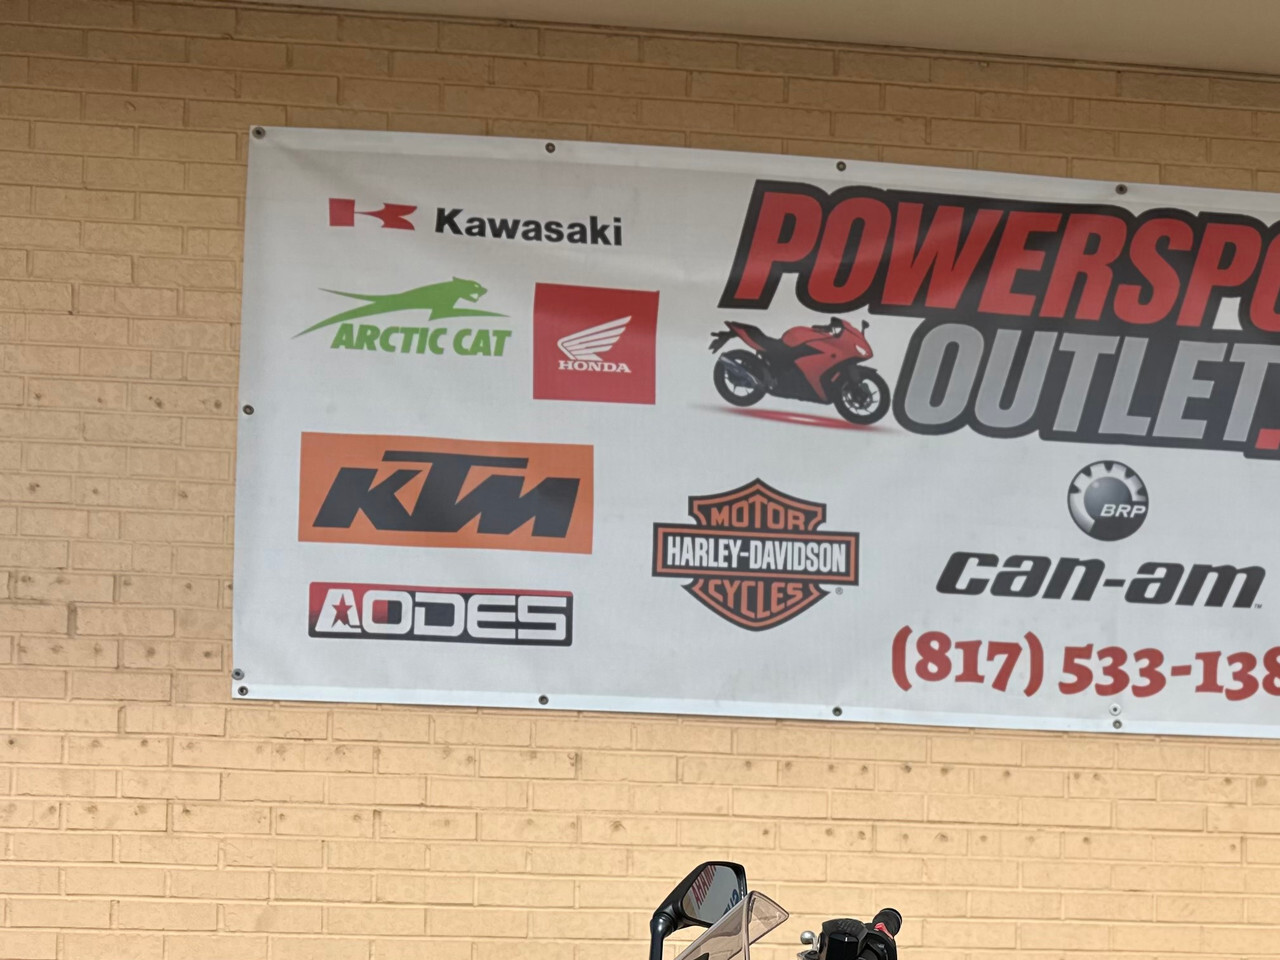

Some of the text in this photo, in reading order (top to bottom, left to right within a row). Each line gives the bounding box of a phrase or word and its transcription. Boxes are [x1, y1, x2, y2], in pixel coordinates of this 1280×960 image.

[434, 207, 623, 246] Kawasaki
[330, 322, 513, 358] ARCTIC CAT
[558, 359, 632, 375] HONDA
[312, 449, 580, 539] KTM
[1099, 503, 1146, 519] BRP
[710, 498, 807, 531] MOTOR
[666, 534, 847, 574] HARLEY-DAVIDSON
[708, 578, 804, 619] CYCLES
[935, 550, 1266, 609] can-am
[891, 624, 1044, 698] (817)
